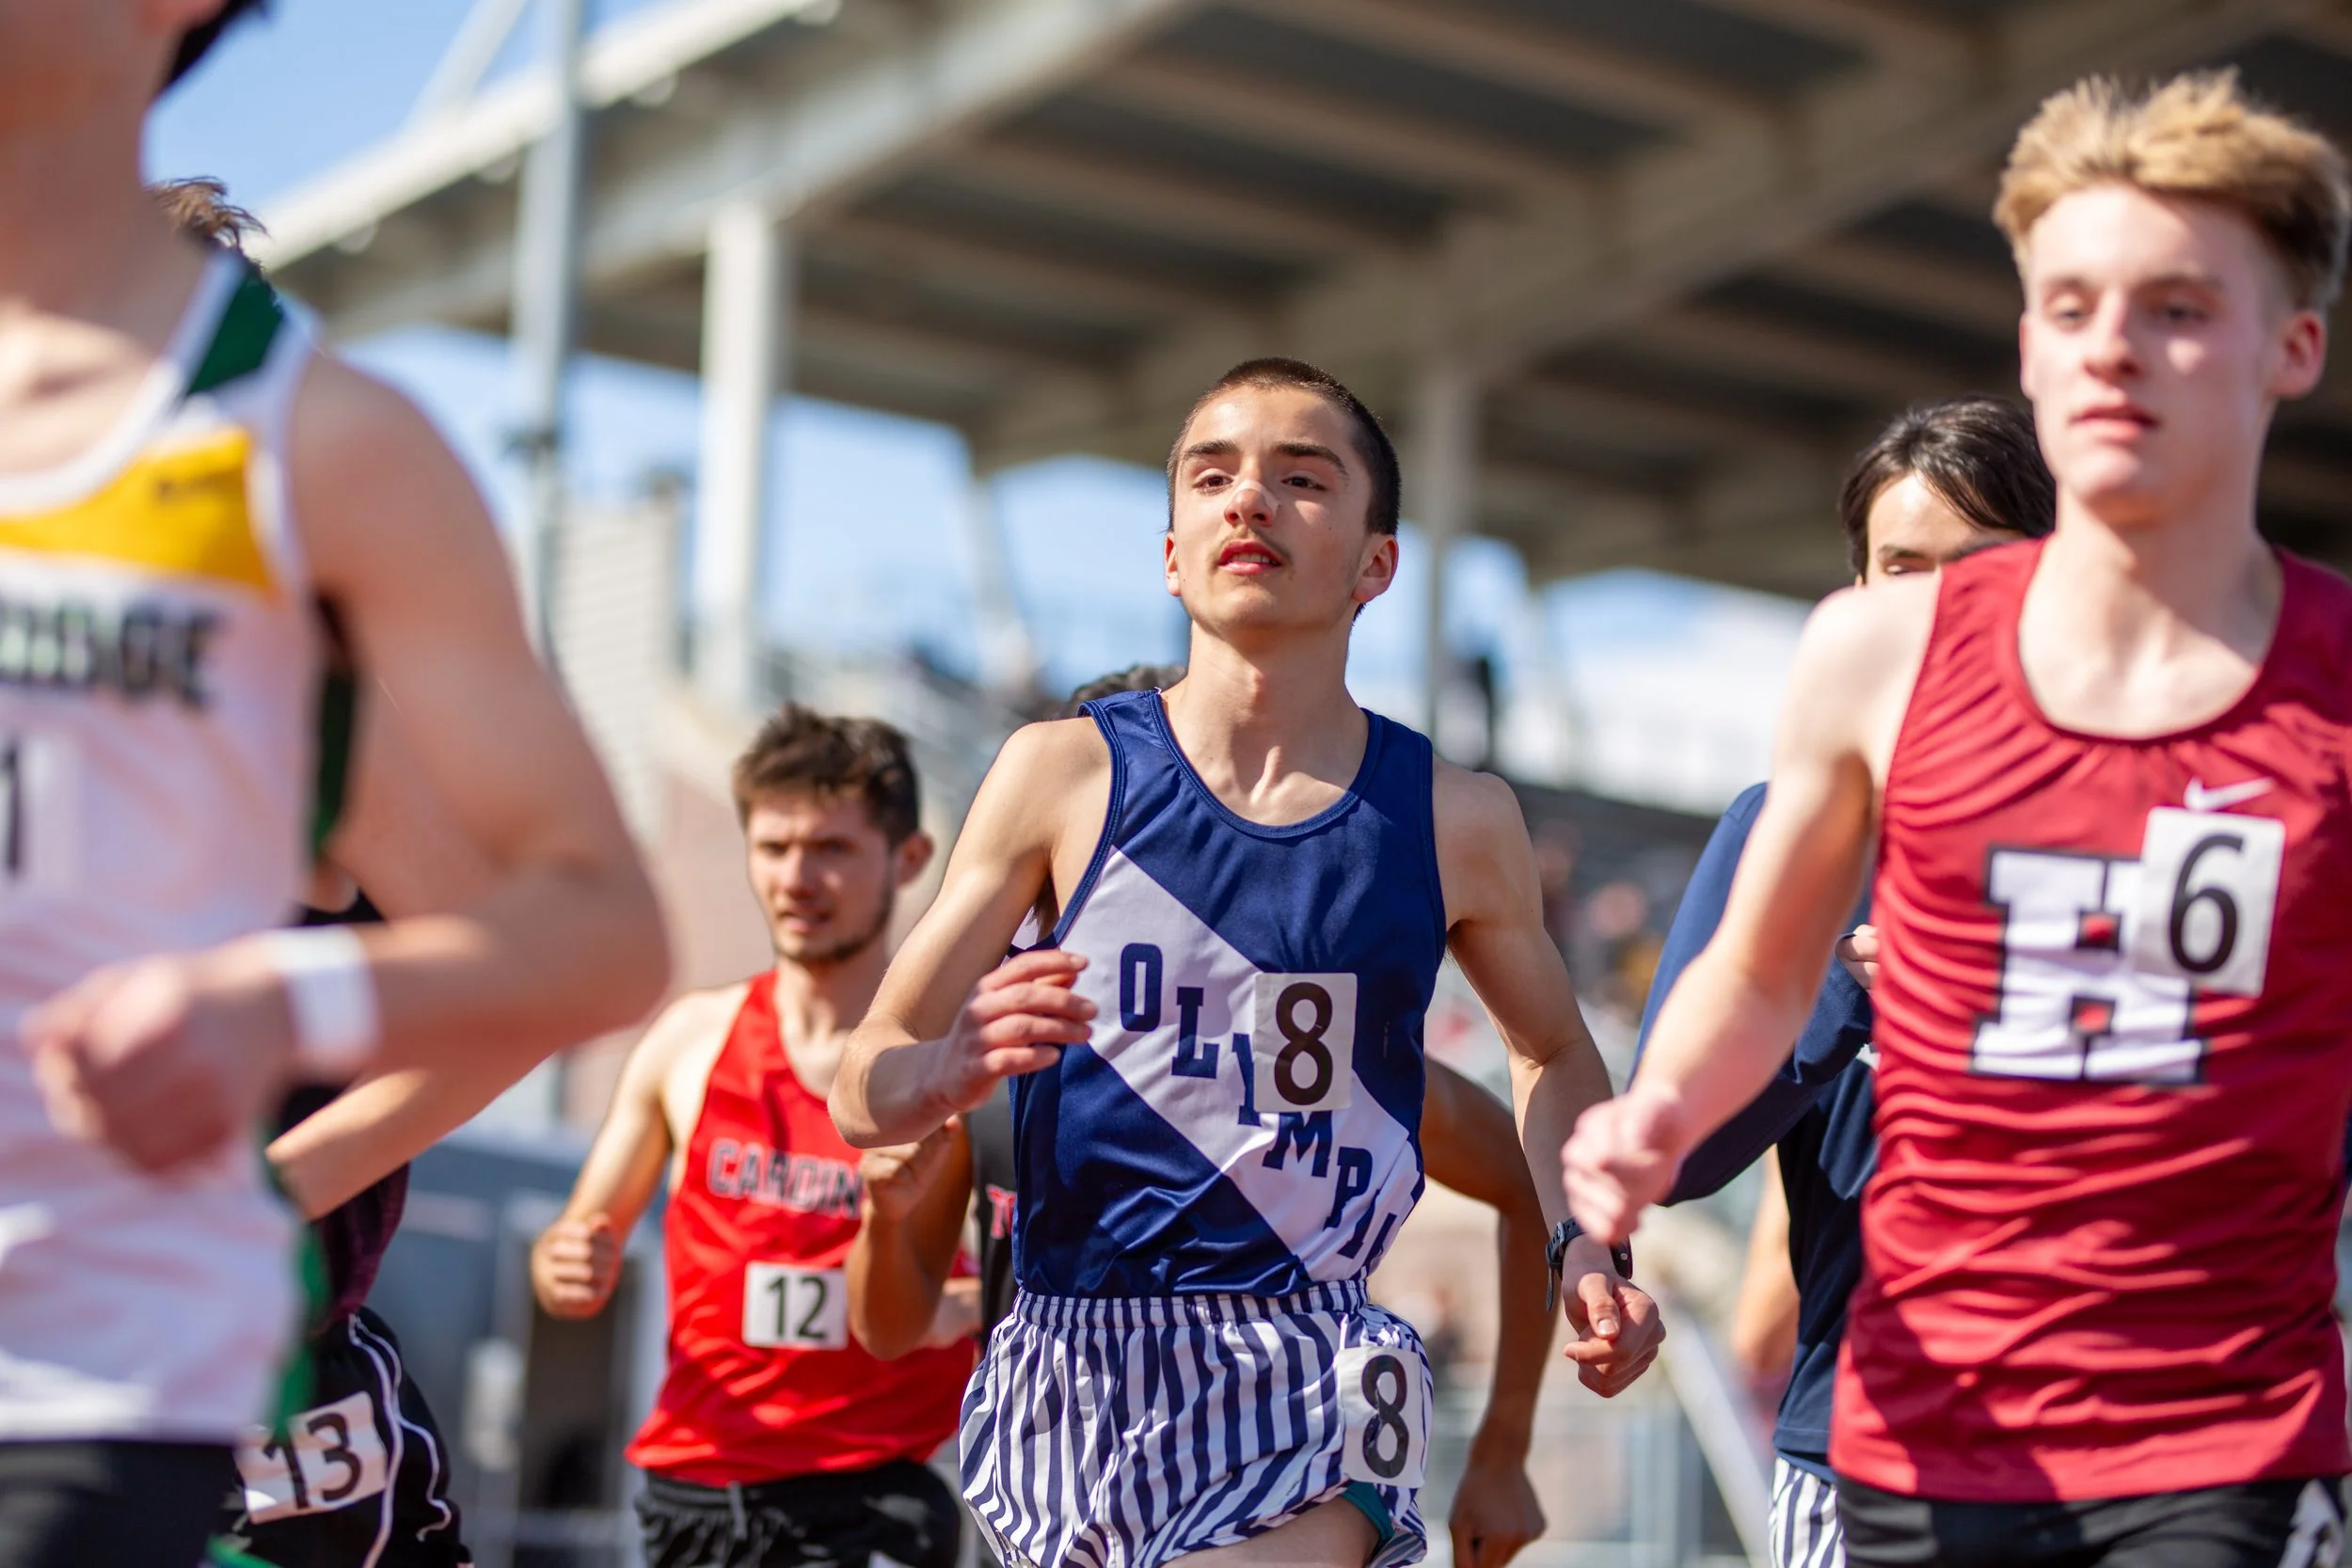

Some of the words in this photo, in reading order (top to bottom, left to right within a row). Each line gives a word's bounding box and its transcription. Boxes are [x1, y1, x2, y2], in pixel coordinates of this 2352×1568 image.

[2169, 832, 2246, 974] 6
[1970, 845, 2208, 1087] H
[1274, 982, 1333, 1106] 8
[766, 1275, 829, 1341] 12
[262, 1413, 363, 1509] 13
[1361, 1354, 1409, 1479] 8
